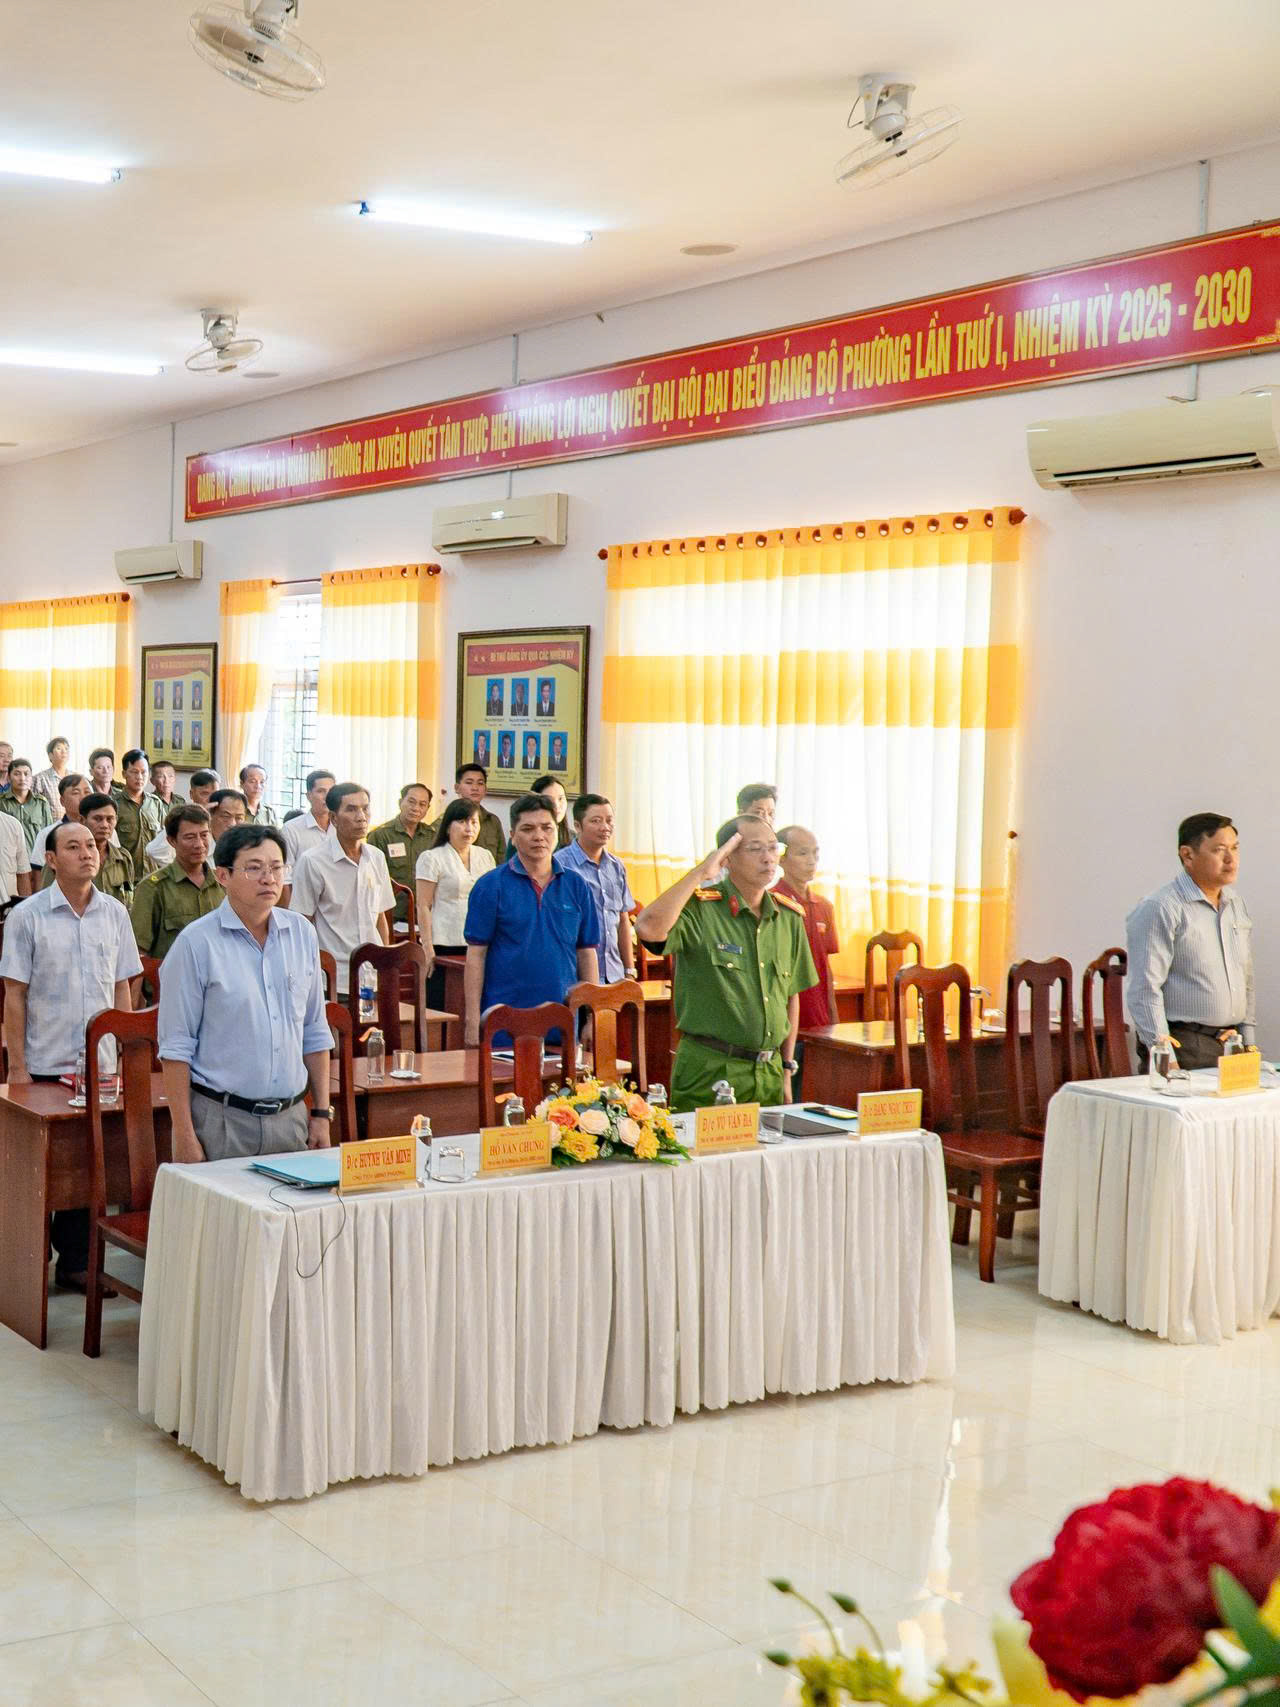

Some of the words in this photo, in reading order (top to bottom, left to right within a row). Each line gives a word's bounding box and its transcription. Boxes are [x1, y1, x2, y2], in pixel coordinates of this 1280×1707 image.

[328, 434, 362, 479] PHƯỜNG
[363, 439, 376, 473] AN
[377, 426, 407, 471] XUYÊN
[409, 414, 438, 469] QUYẾT
[440, 416, 461, 460] TÂM
[463, 413, 489, 462] THỰC
[491, 404, 516, 458] HIỆN
[518, 394, 555, 447] THẮNG
[558, 396, 577, 448] LỢI
[579, 392, 608, 442] NGHỊ
[610, 371, 650, 435] QUYẾT
[653, 380, 674, 431] ĐẠI
[678, 367, 701, 428] HỘI
[704, 372, 729, 424] ĐẠI
[732, 345, 765, 411] BIỂU
[769, 337, 813, 404] ĐẢNG
[816, 340, 839, 405] BỘ
[842, 326, 912, 395] PHƯỜNG
[915, 311, 952, 380] LẦN
[956, 303, 995, 372] THỨ
[996, 314, 1008, 371] I,
[1014, 293, 1079, 367] NHIỆM
[1085, 283, 1115, 349] KỲ
[1118, 282, 1173, 345] 2025
[1178, 303, 1188, 317] -
[1193, 266, 1253, 332] 2030
